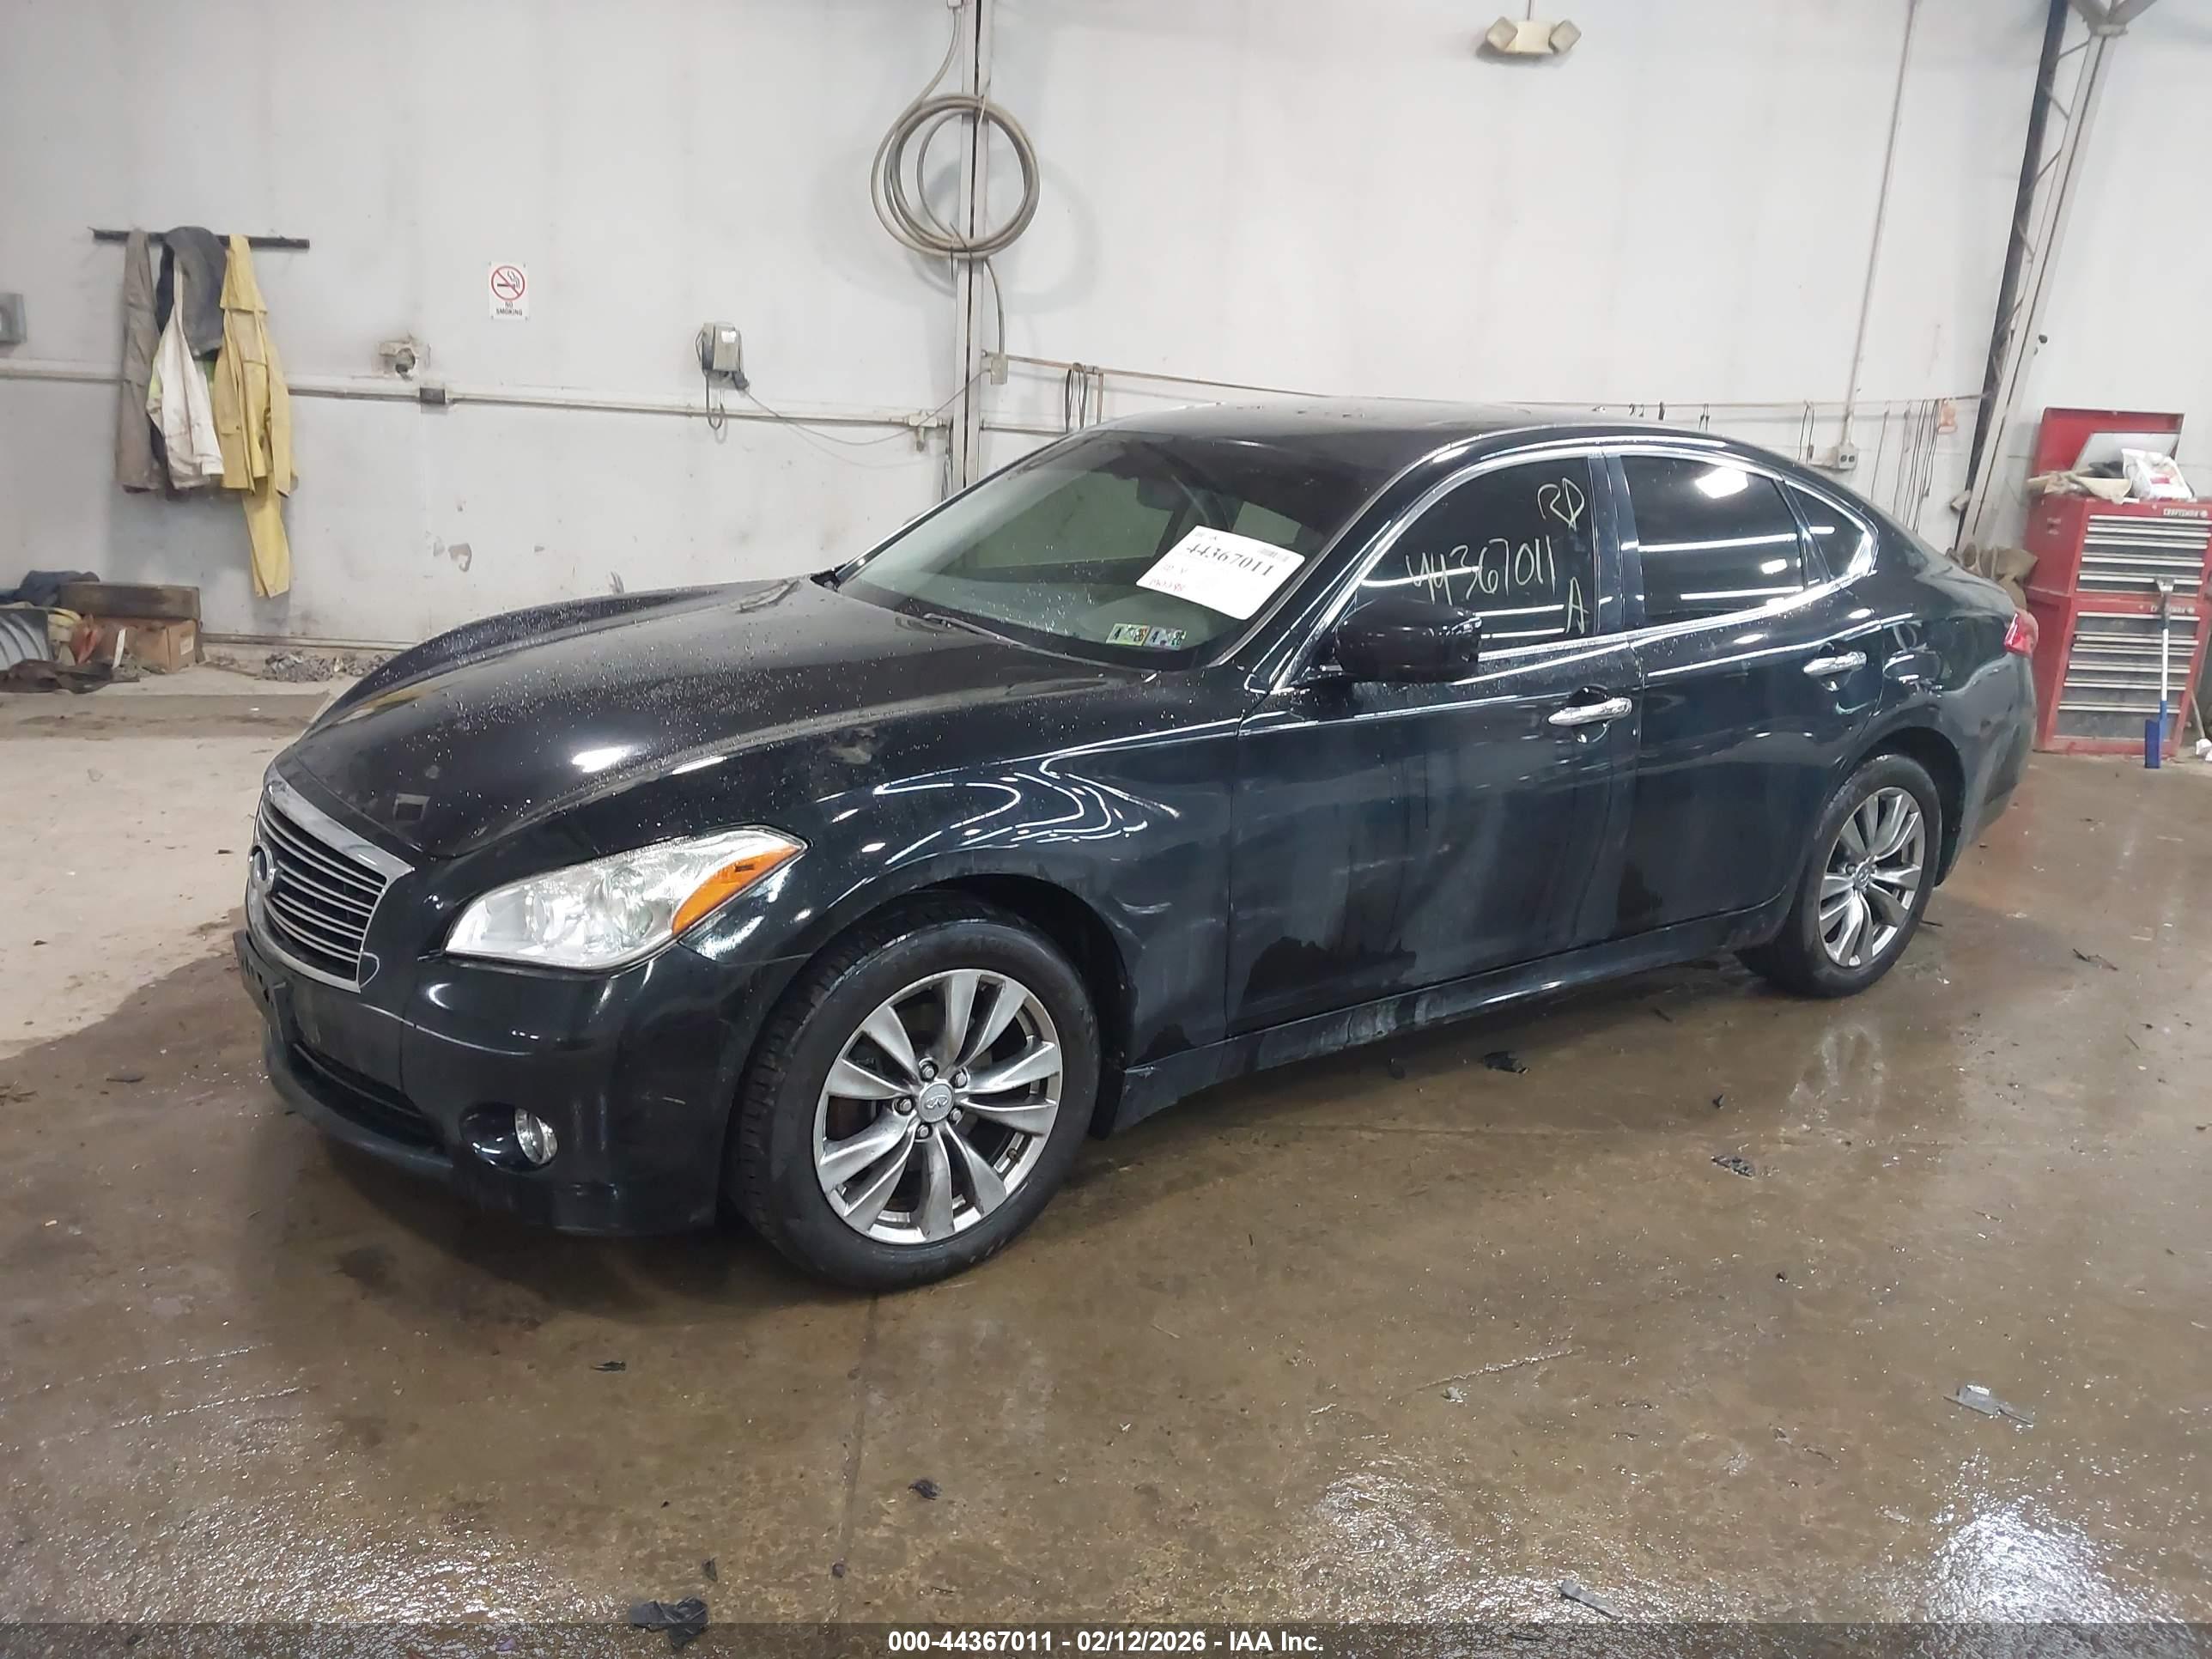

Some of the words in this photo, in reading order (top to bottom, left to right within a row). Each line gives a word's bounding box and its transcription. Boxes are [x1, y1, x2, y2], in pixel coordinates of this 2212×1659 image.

[1186, 542, 1275, 577] 44367011
[1405, 535, 1556, 605] 44367011
[1565, 576, 1589, 635] A
